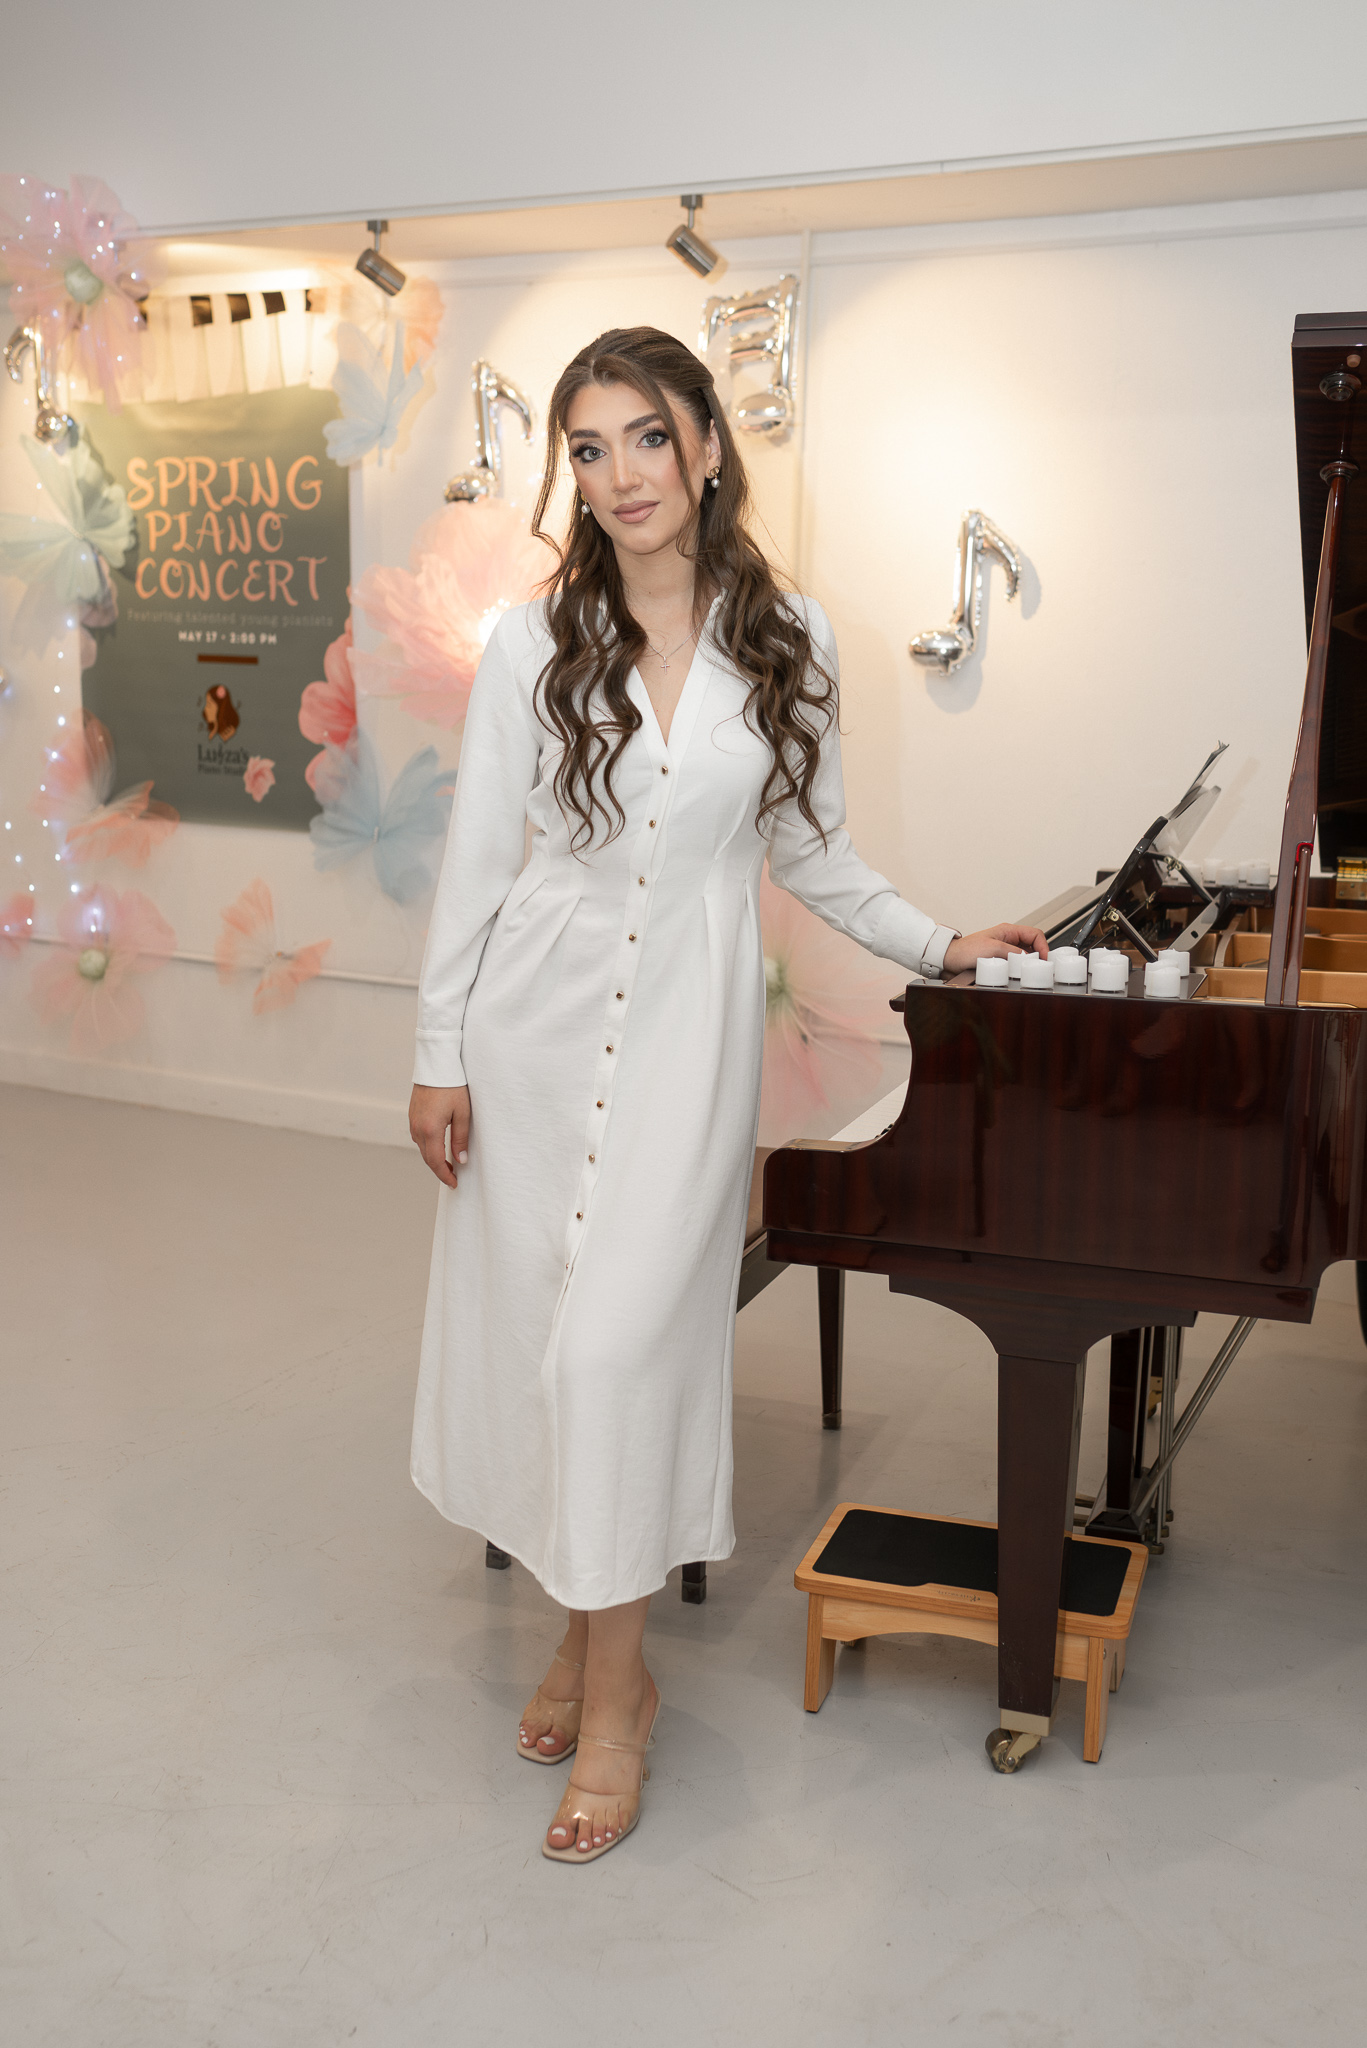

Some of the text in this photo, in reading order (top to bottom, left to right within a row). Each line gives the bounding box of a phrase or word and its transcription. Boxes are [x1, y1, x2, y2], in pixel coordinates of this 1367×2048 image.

[127, 455, 323, 512] SPRING
[144, 510, 288, 555] PIANO
[135, 557, 327, 606] CONCERT
[127, 608, 334, 628] Featuring talented young pianists
[178, 630, 277, 645] MAY 17 2:00 PM
